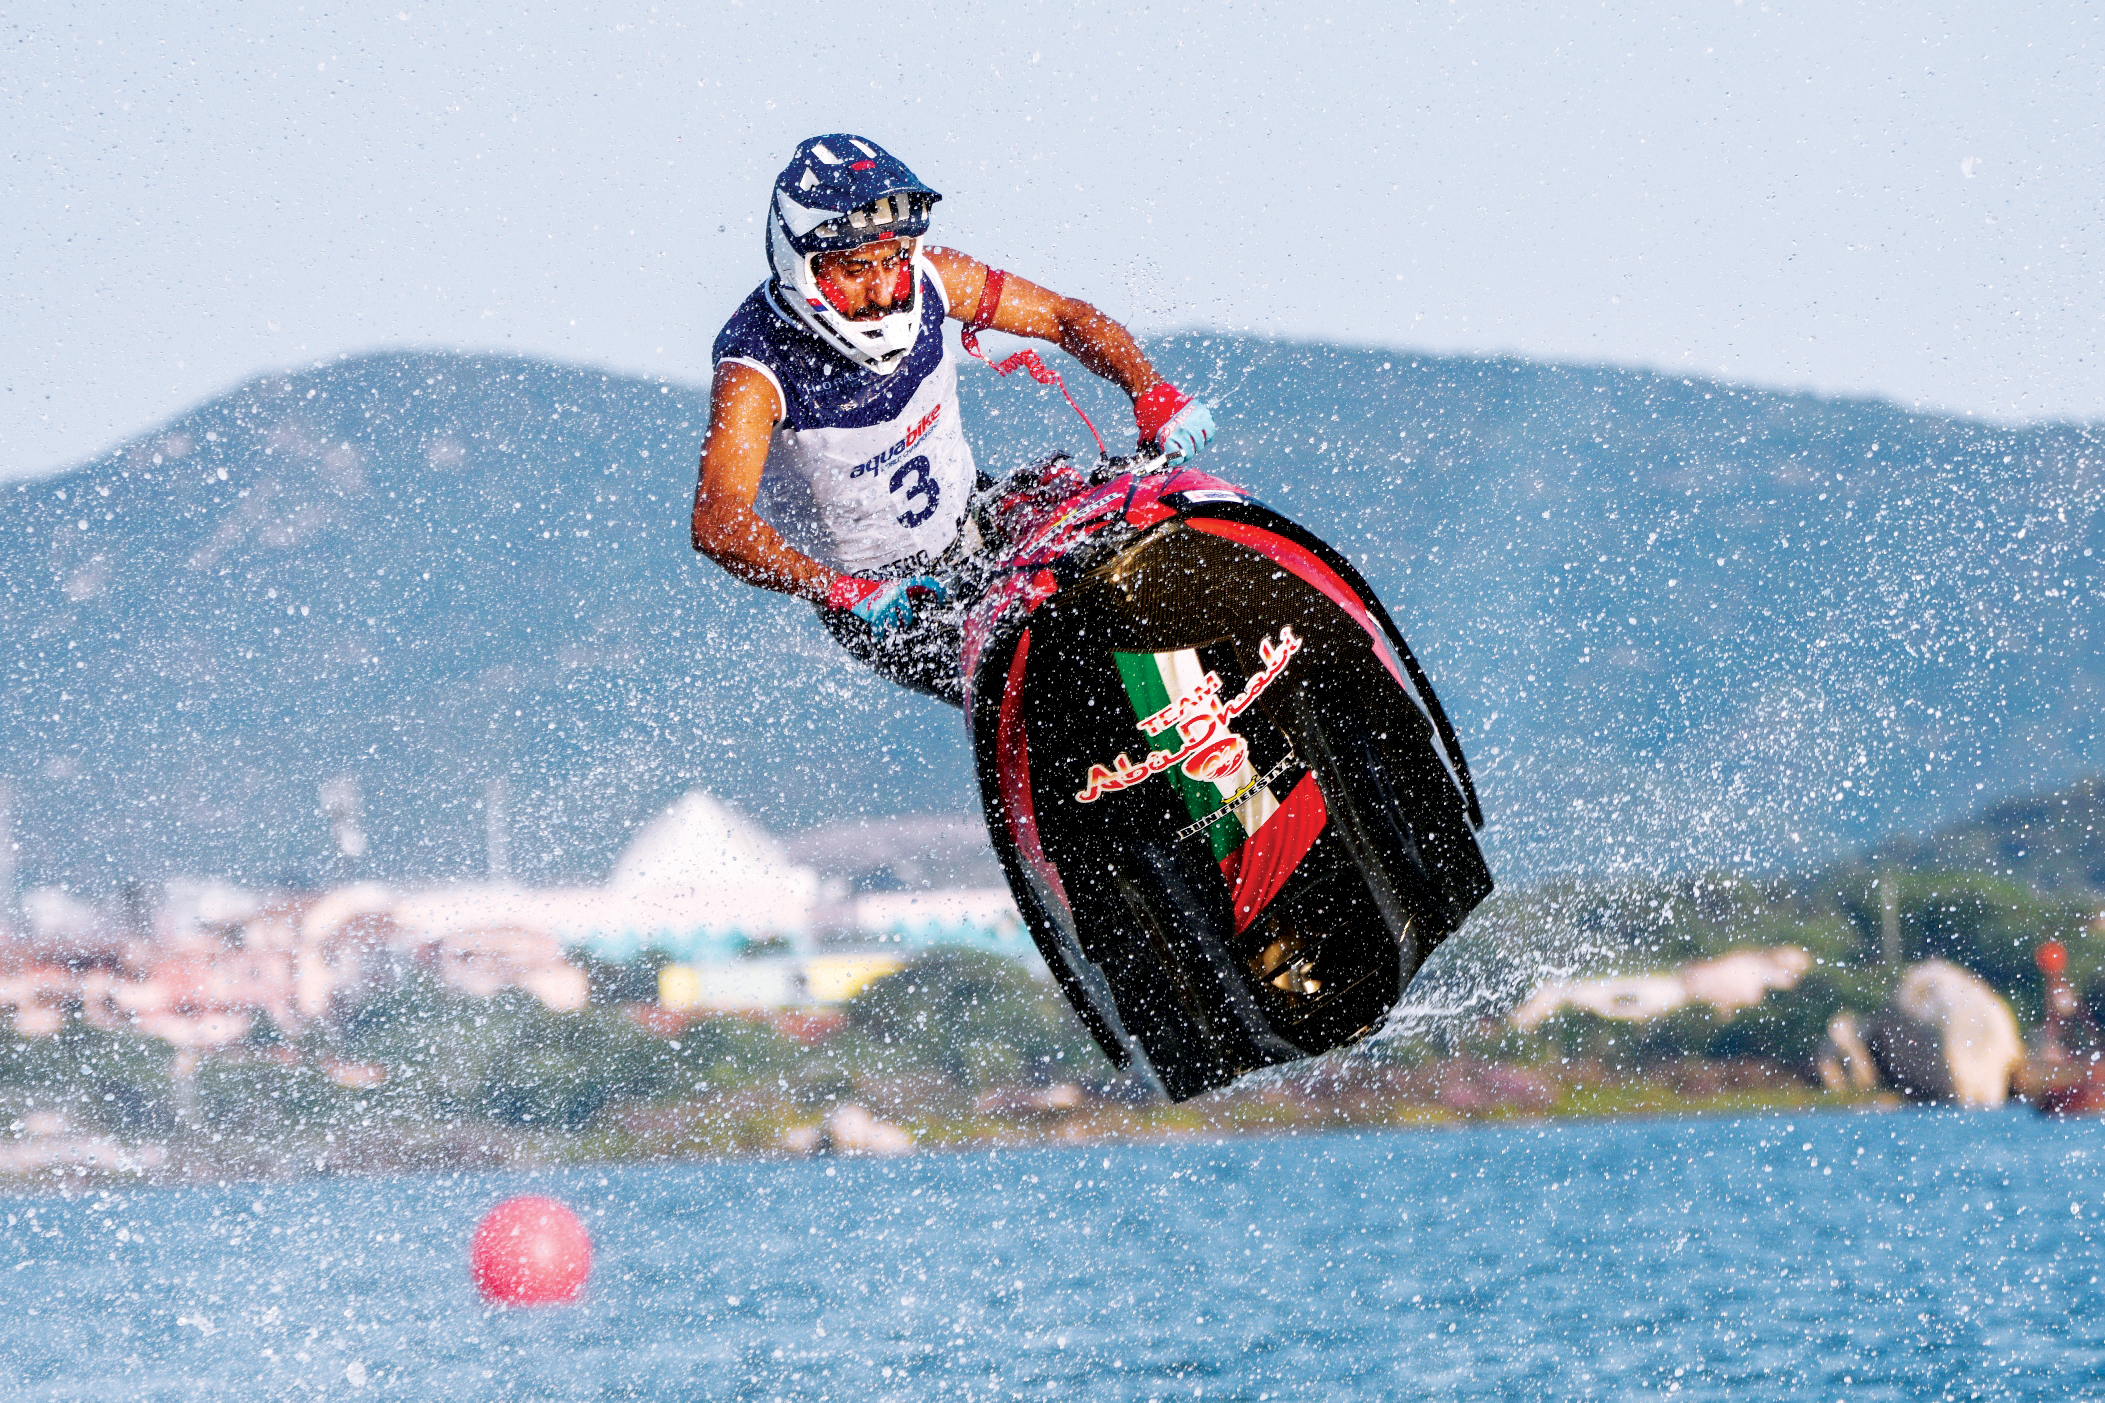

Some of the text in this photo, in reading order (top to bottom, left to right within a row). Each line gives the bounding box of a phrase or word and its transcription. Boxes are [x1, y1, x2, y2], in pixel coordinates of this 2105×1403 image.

[804, 381, 832, 395] HO
[849, 403, 941, 479] aquabike
[889, 455, 940, 529] 3
[1137, 671, 1222, 736] TEAM
